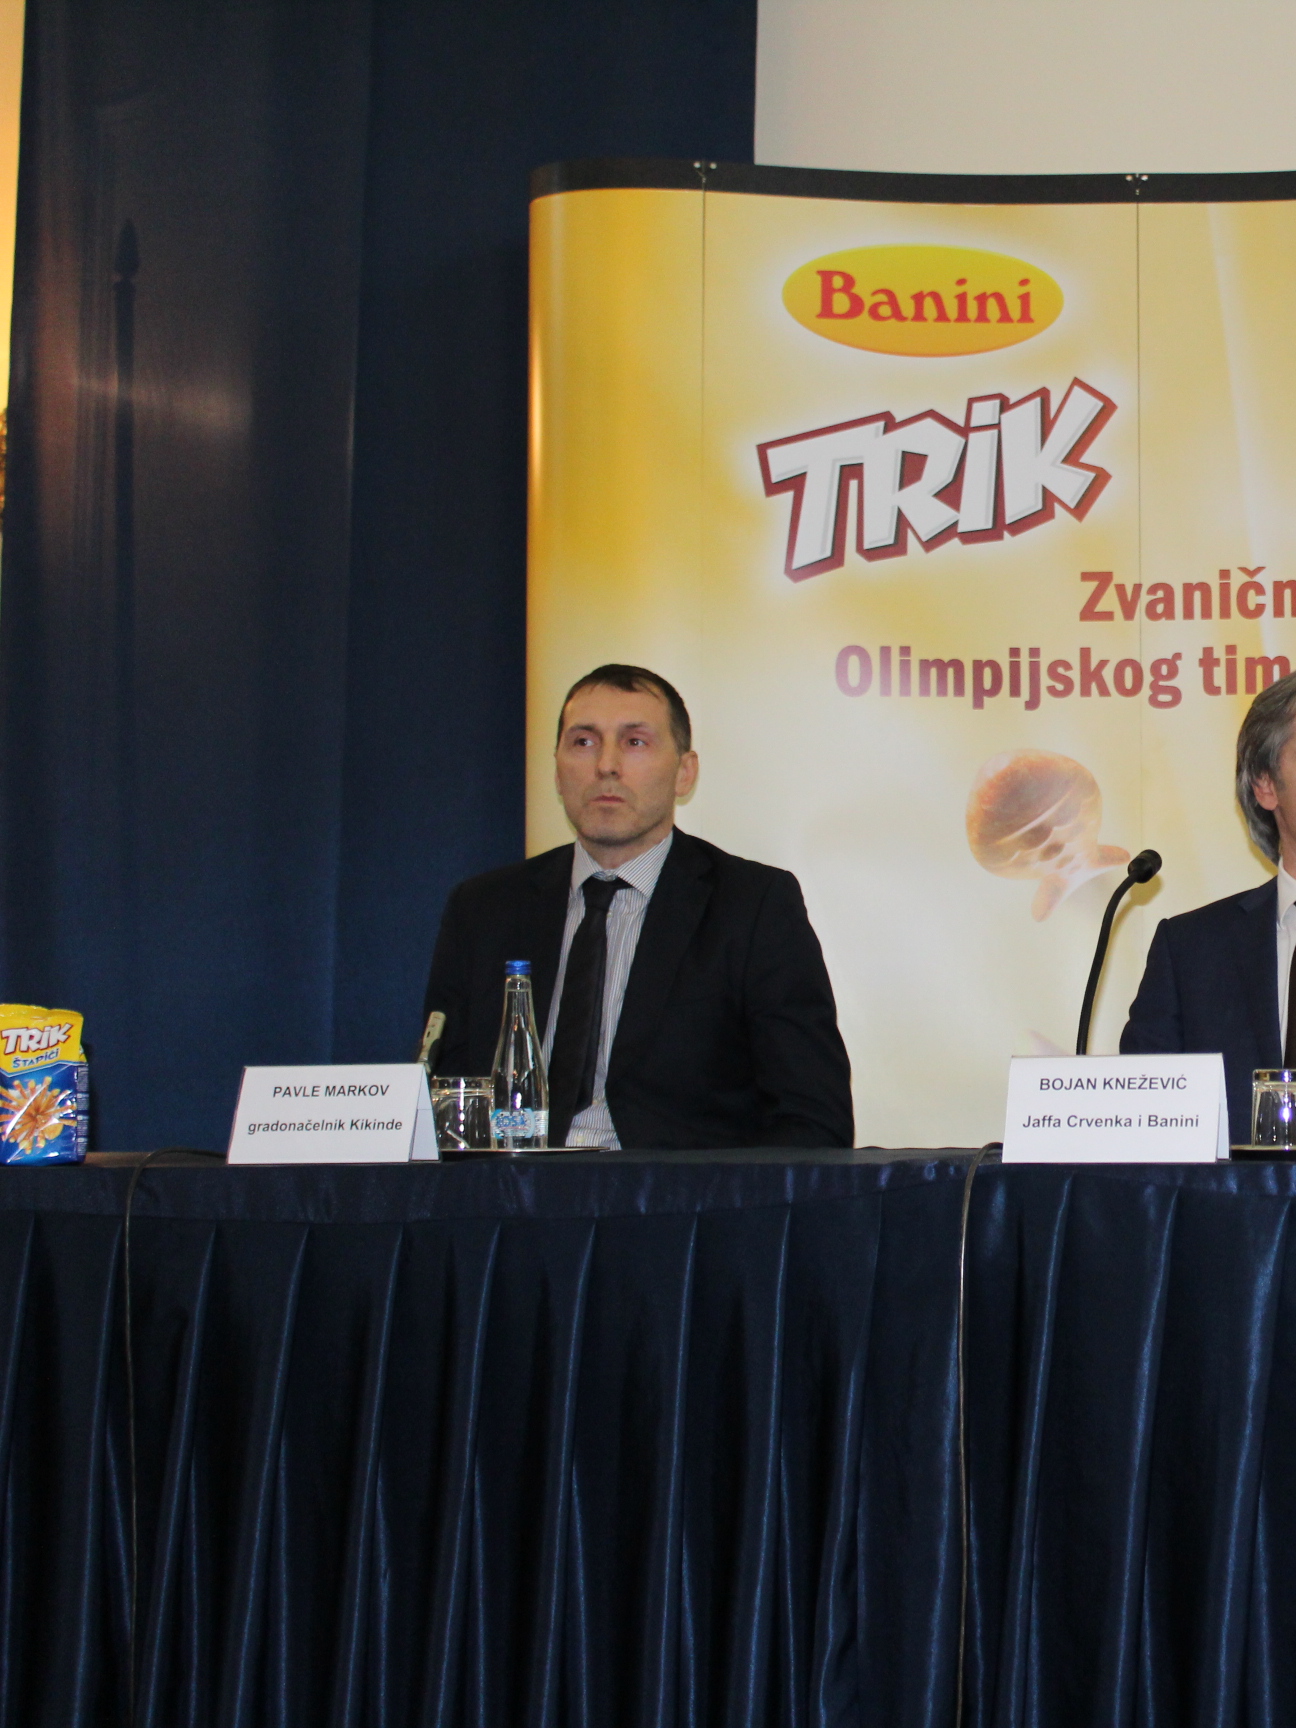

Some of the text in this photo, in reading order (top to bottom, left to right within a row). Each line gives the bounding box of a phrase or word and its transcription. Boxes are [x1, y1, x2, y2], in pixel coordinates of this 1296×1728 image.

[815, 270, 1035, 324] Banini
[834, 644, 1183, 711] Olimpijskog
[273, 1084, 390, 1098] PAVLE MARKOV
[1039, 1074, 1187, 1091] BOJAN KNEŽEVIĆ
[248, 1118, 403, 1135] gradonačelnik Kikinde
[1022, 1114, 1199, 1128] Jaffa Crvenka i Banini
